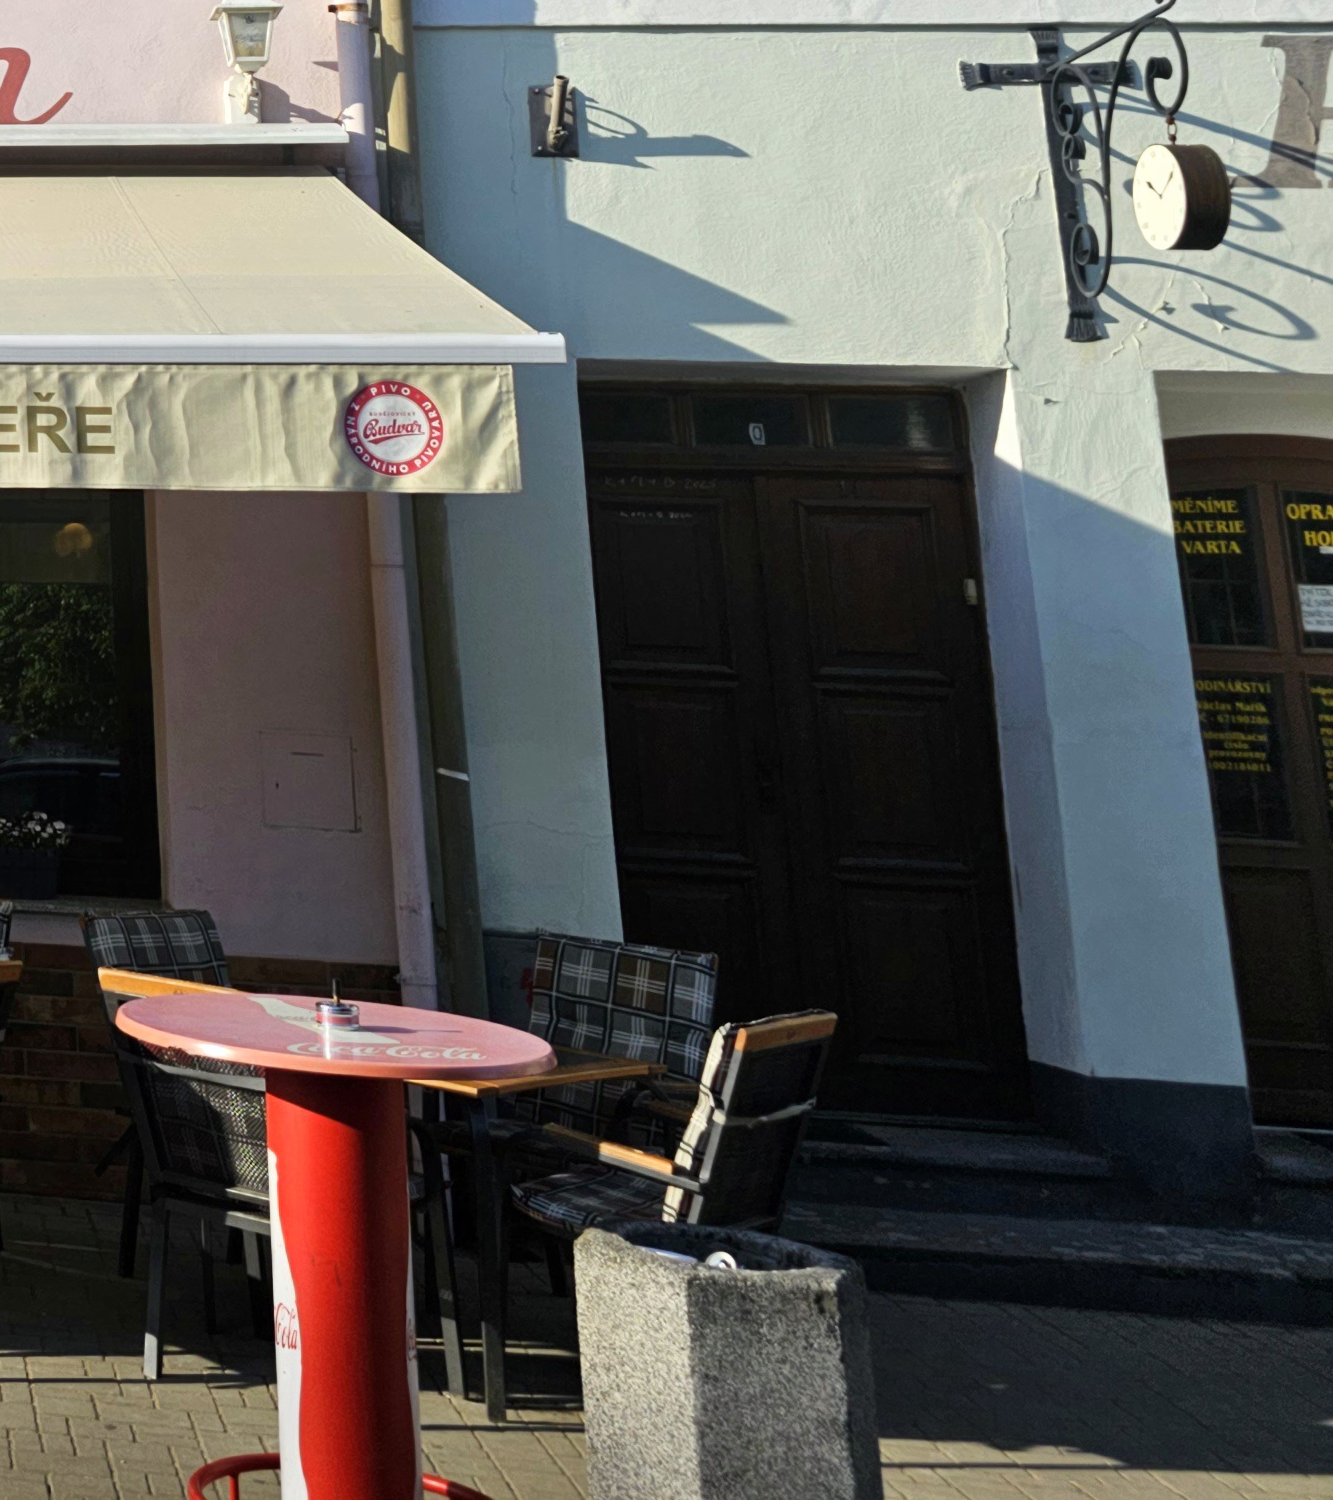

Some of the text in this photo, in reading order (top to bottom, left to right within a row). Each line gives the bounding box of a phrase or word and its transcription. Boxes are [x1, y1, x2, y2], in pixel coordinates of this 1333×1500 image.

[370, 384, 411, 396] PIVO
[362, 418, 425, 440] Budvar
[1174, 520, 1246, 534] BATERIE
[1304, 530, 1333, 547] HO
[1181, 540, 1242, 555] VARTA
[1195, 678, 1272, 694] ODINÁŘSTVÍ
